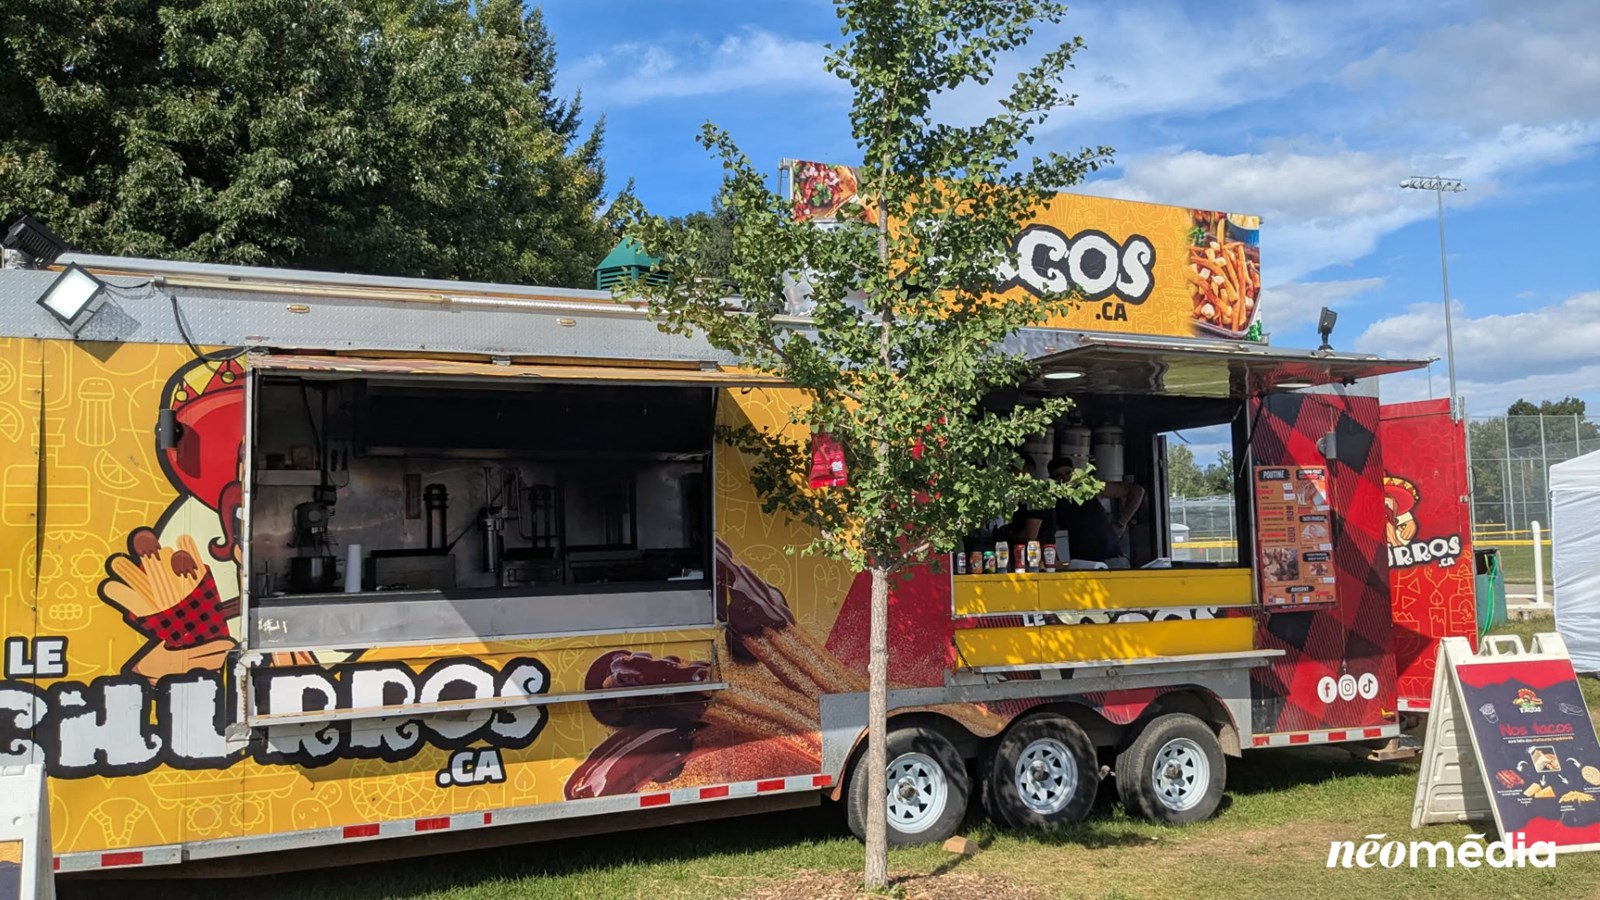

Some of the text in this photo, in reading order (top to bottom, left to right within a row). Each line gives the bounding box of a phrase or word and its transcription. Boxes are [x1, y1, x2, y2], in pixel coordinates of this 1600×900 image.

[1096, 302, 1128, 321] .CA
[1263, 470, 1285, 479] POUTINE
[1439, 557, 1456, 568] .CA
[1022, 613, 1046, 627] LE
[9, 640, 64, 675] LE
[1519, 706, 1542, 714] TACOS
[1499, 721, 1574, 736] Nos tacos
[439, 750, 503, 784] .CA
